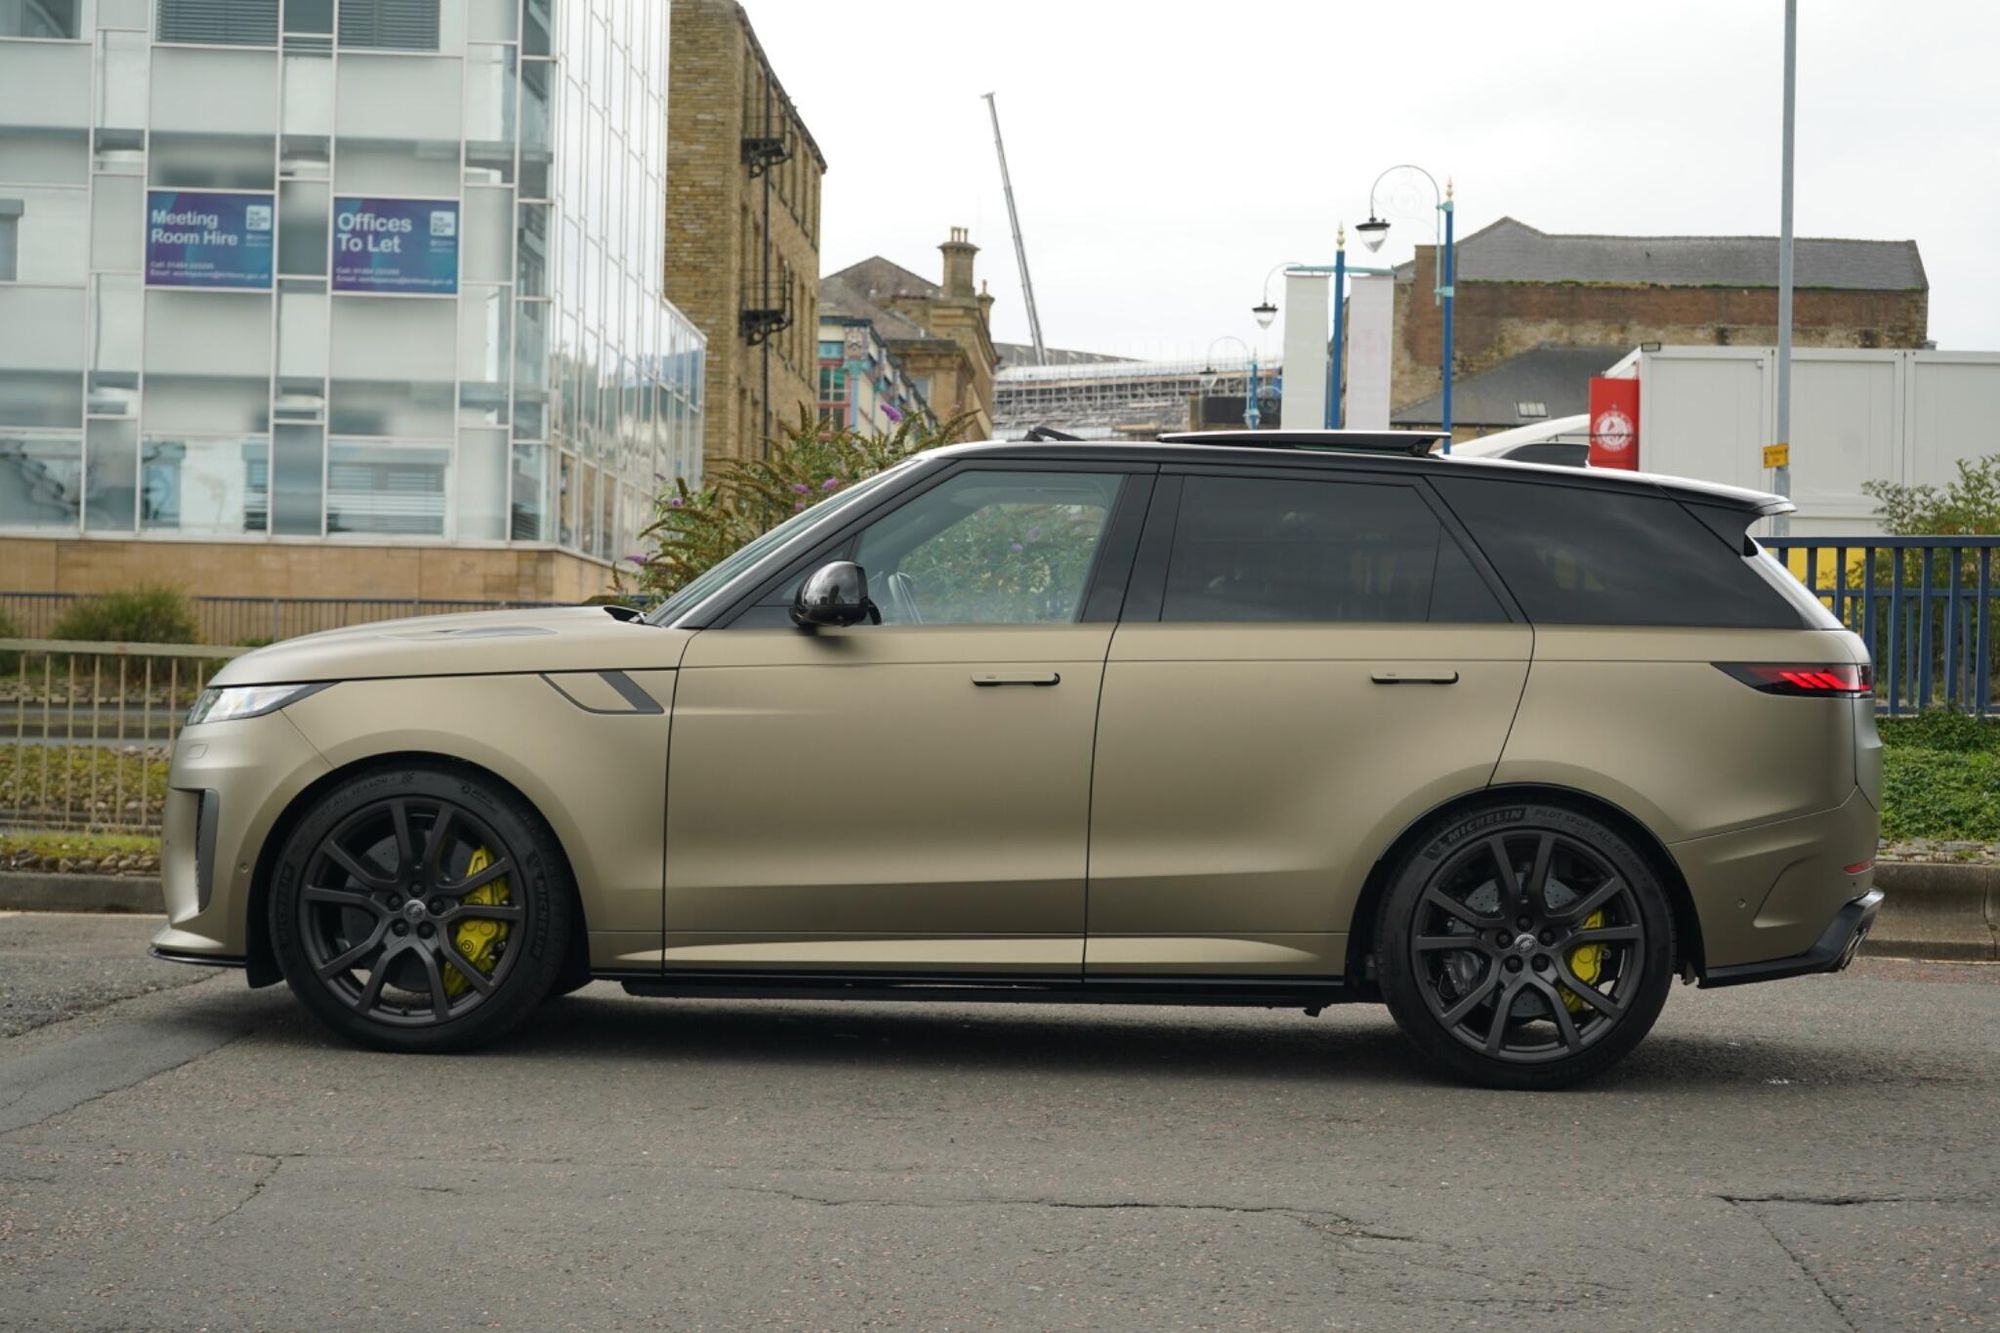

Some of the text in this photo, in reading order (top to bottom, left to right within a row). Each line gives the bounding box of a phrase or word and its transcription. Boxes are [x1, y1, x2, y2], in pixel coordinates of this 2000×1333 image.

[152, 209, 218, 229] Meeting
[338, 212, 412, 232] Offices
[152, 228, 199, 244] Room
[203, 230, 238, 246] Hire
[337, 233, 401, 253] To Let
[1448, 808, 1522, 842] MICHELIN
